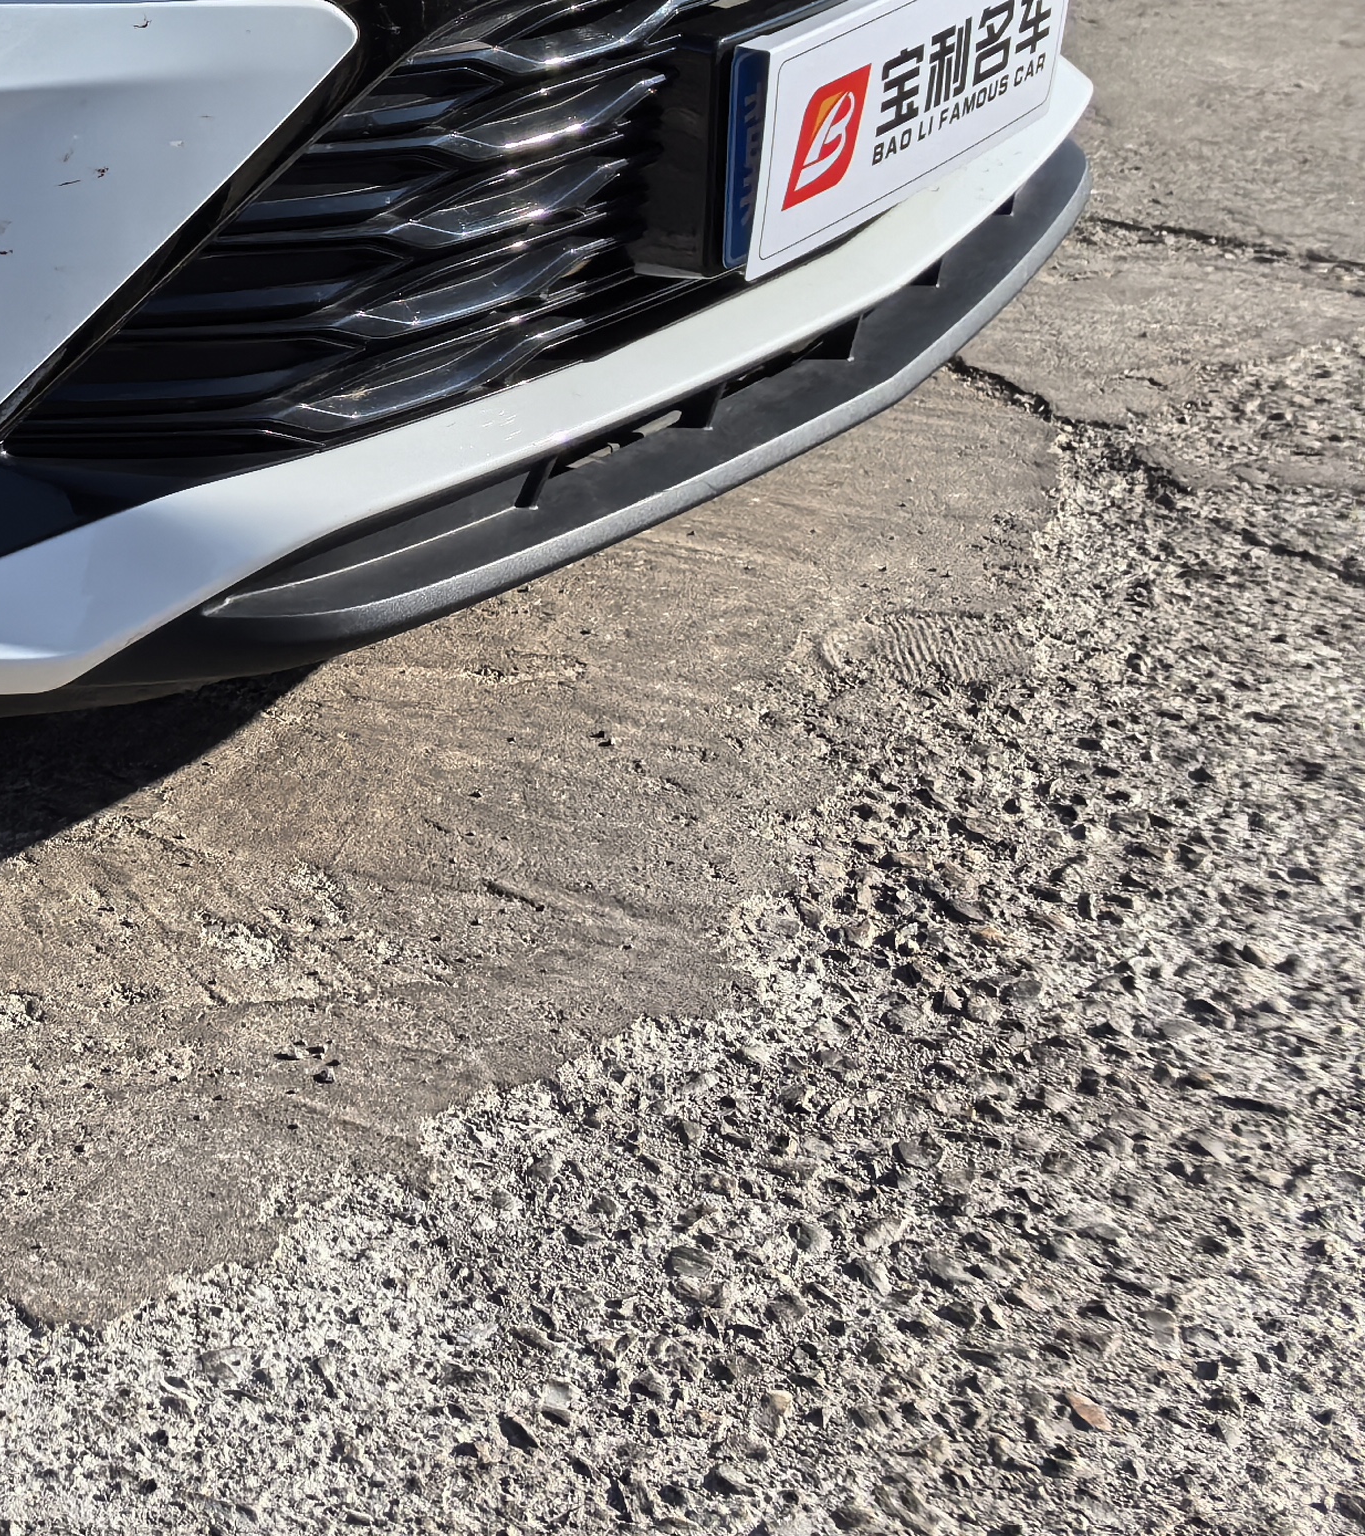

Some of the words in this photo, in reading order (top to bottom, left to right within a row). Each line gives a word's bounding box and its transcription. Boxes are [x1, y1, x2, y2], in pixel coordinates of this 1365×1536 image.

[872, 128, 912, 166] BAO
[917, 115, 934, 141] LI
[938, 74, 1009, 130] FAMOUS
[1014, 52, 1046, 87] CAR
